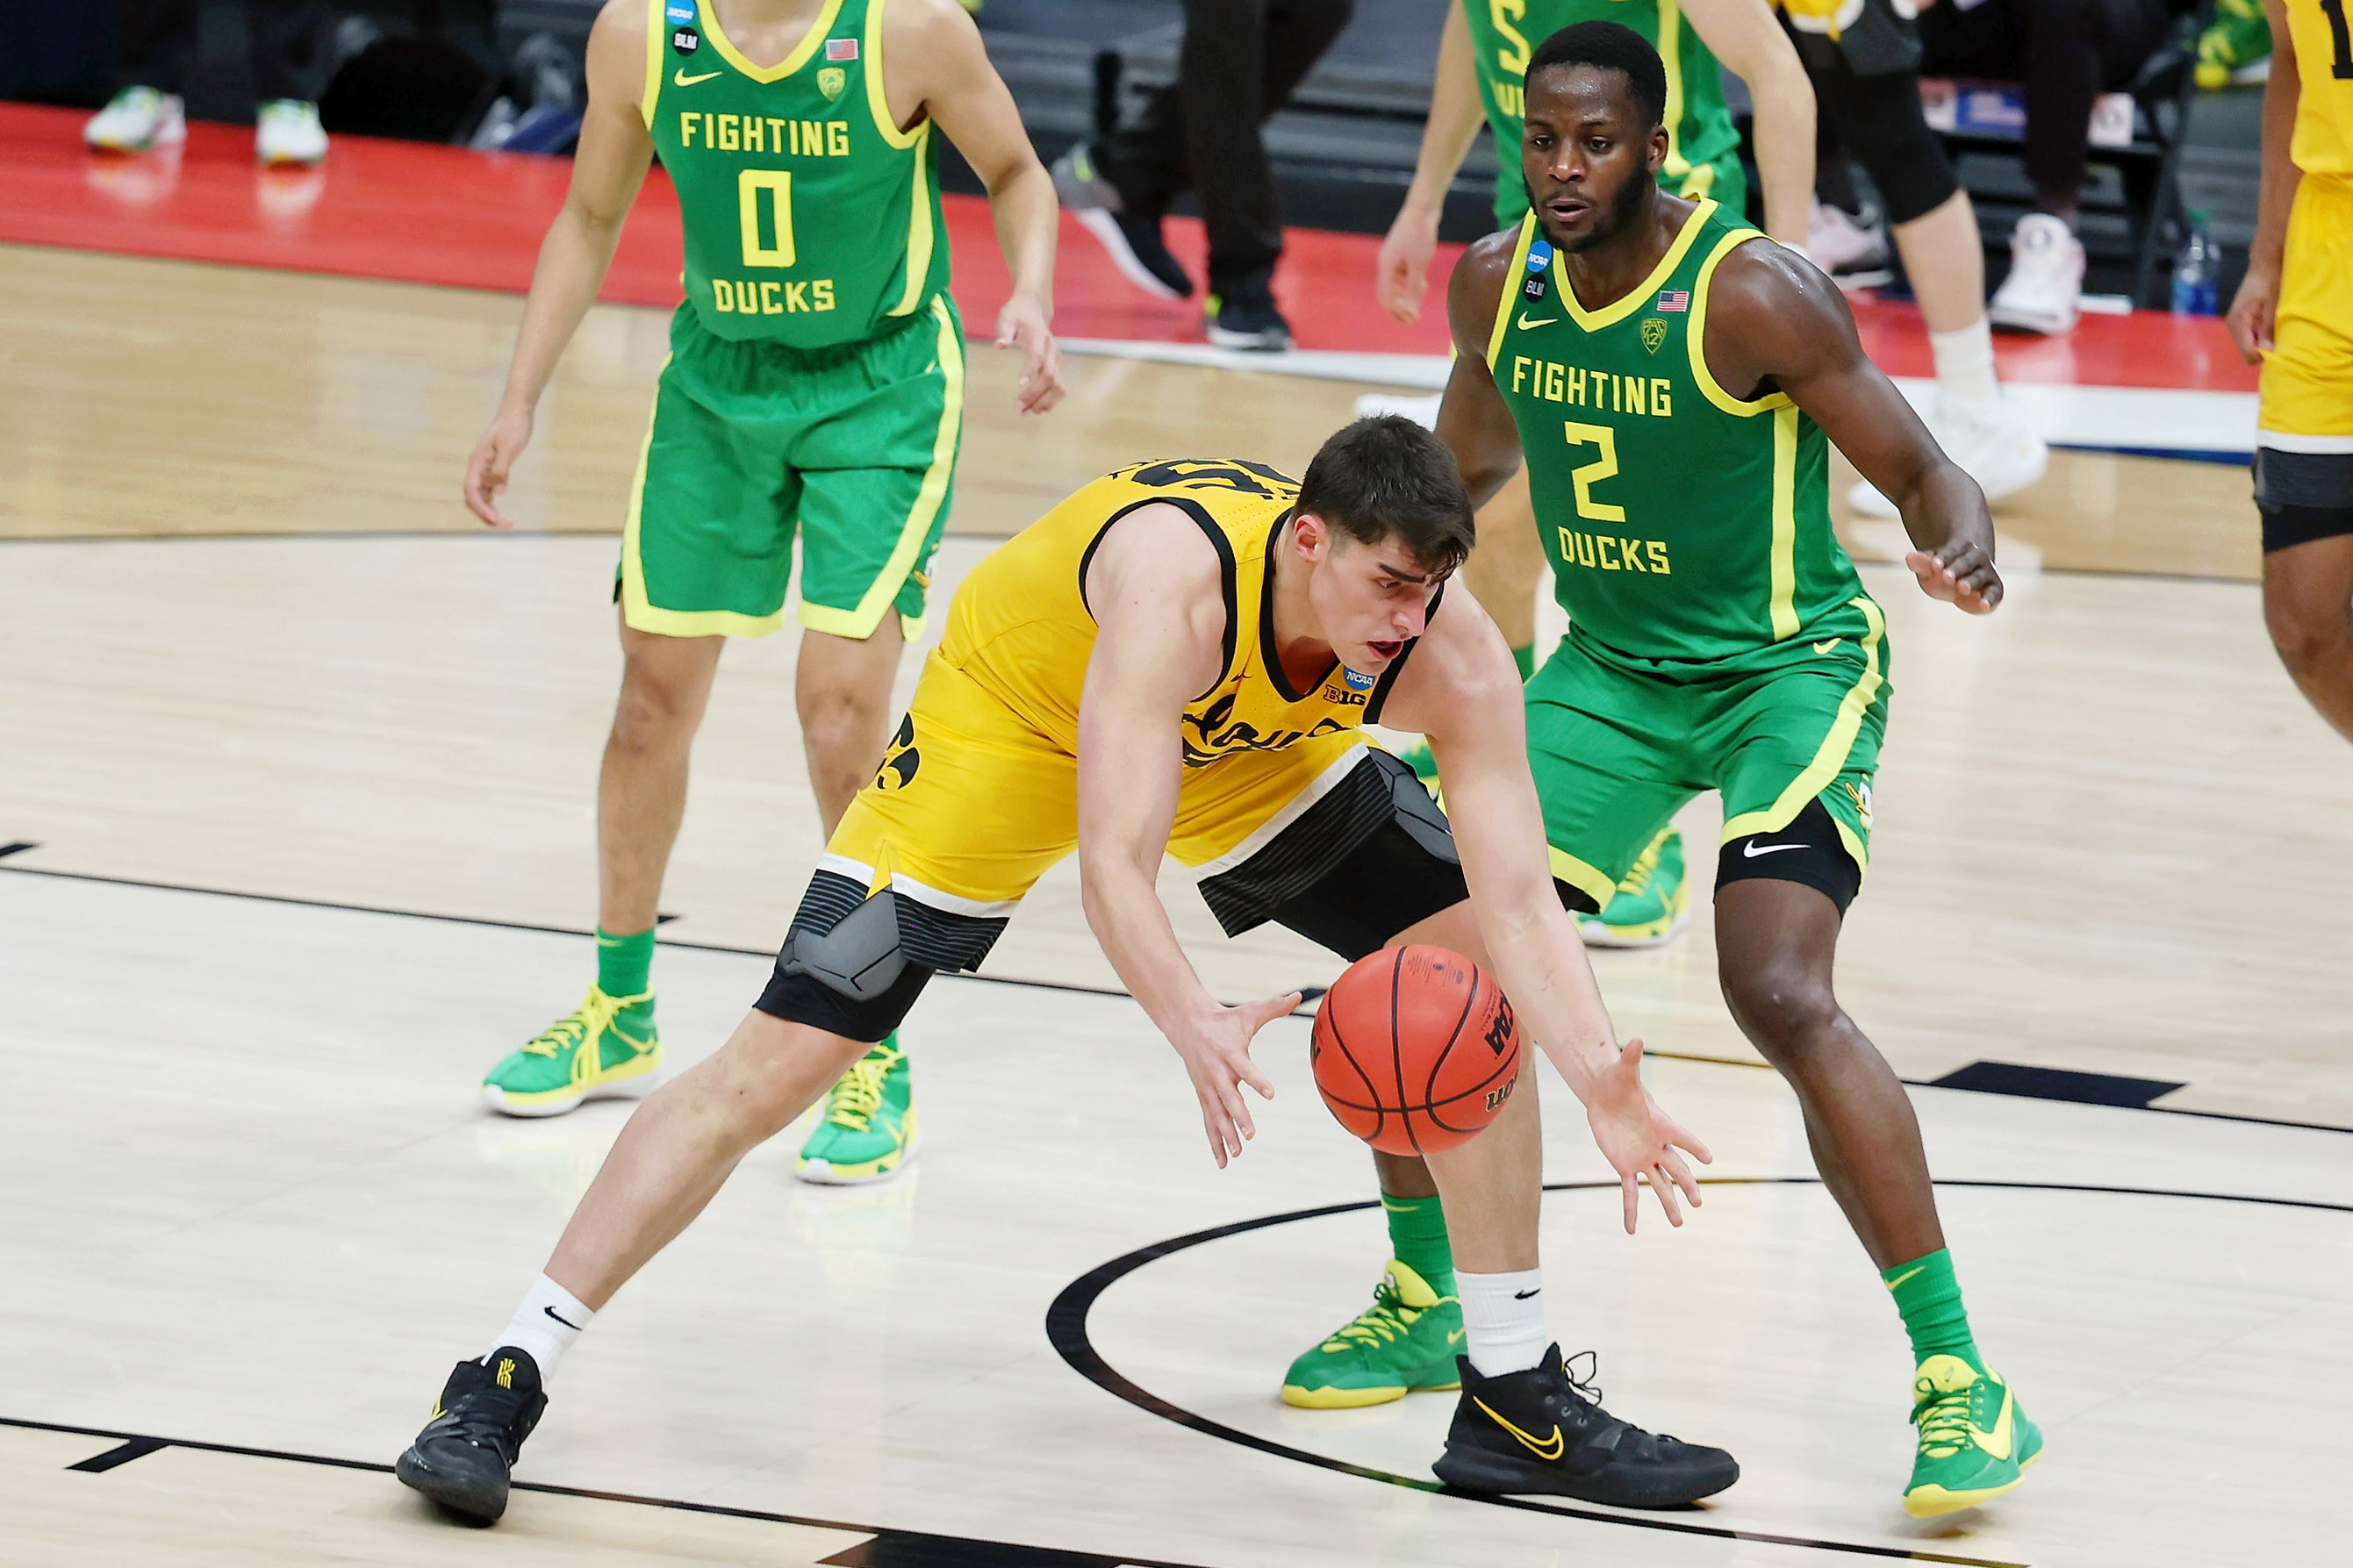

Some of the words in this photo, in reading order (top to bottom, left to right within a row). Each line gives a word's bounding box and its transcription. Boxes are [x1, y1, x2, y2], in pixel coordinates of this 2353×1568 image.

[674, 32, 698, 49] BLM
[680, 111, 850, 156] FIGHTING
[738, 168, 796, 268] 0
[712, 278, 836, 315] DUCKS
[1511, 354, 1673, 418] FIGHTING
[1564, 420, 1626, 523] 2
[1557, 526, 1671, 575] DUCKS
[1346, 671, 1374, 686] NCAA
[1484, 990, 1514, 1056] CAA
